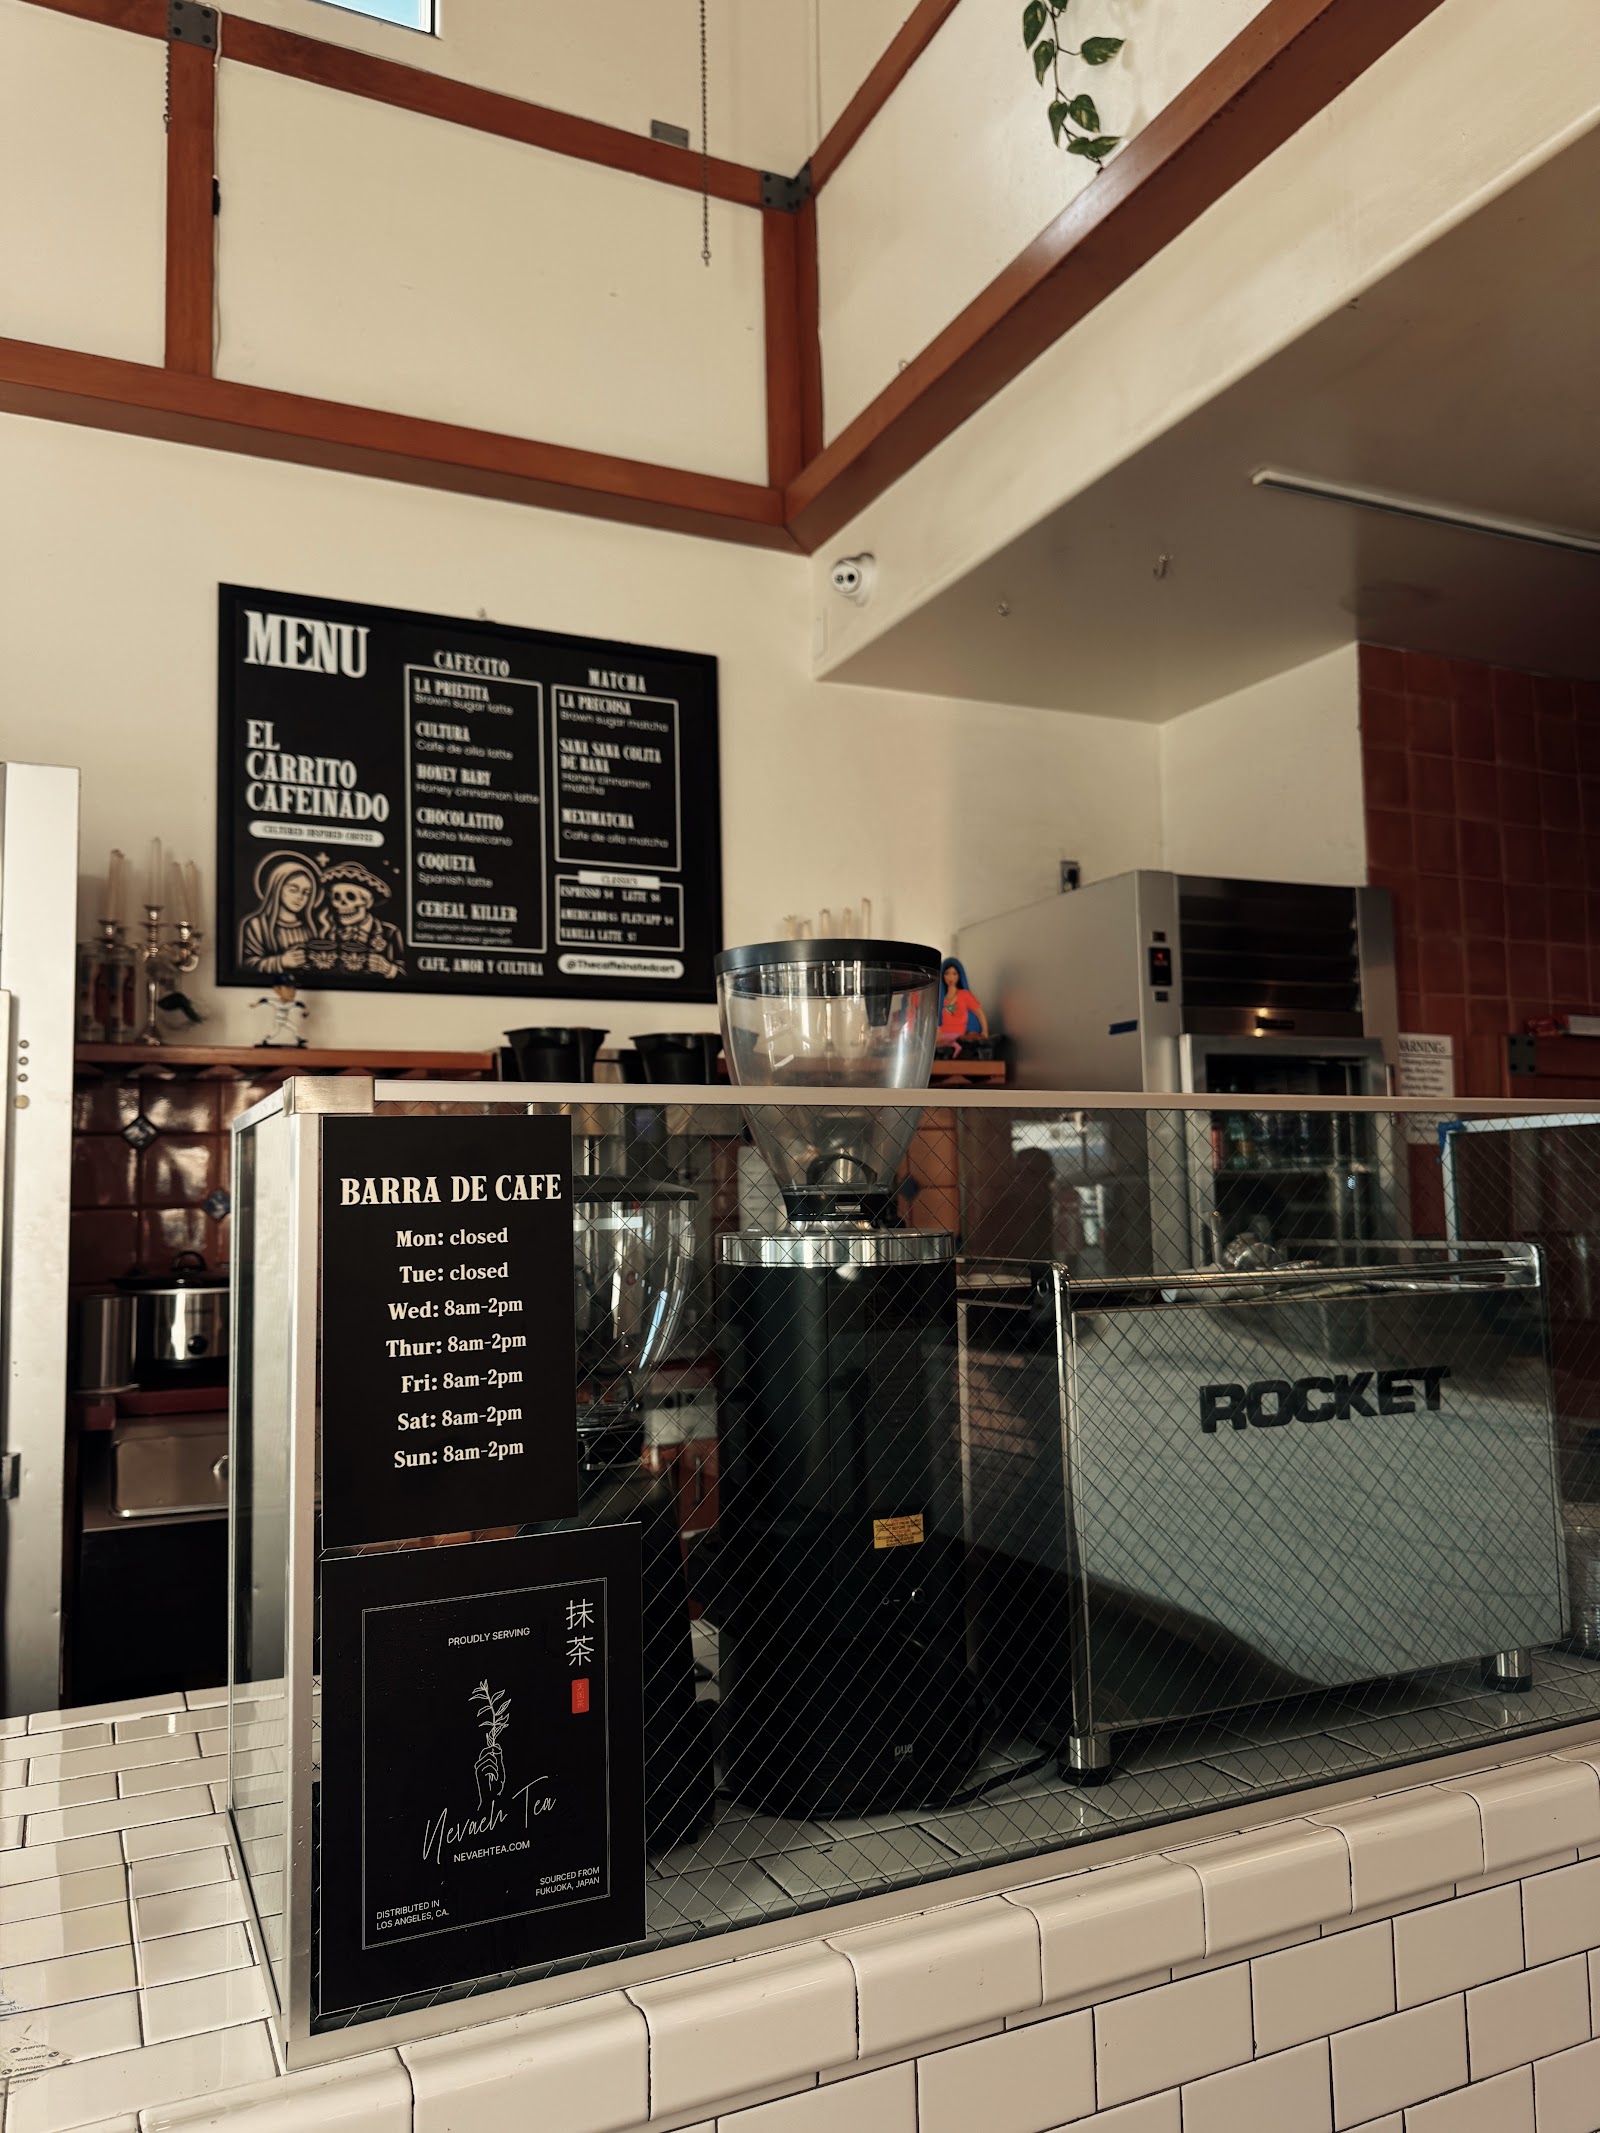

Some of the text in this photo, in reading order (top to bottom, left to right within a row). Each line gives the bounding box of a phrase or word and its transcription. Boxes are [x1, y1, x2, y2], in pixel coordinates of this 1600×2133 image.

[243, 609, 370, 678] MENU
[433, 649, 510, 677] CAFECITO
[413, 676, 431, 694] LA
[588, 668, 647, 693] MATCHA
[414, 694, 514, 715] Brown sugar latte
[558, 691, 632, 716] LA PRECIOSA
[415, 720, 471, 742] CULTURA
[560, 708, 669, 733] Brown sugar matcha
[246, 718, 280, 751] EL
[415, 739, 514, 760] Cafe de olla latte
[559, 737, 662, 764] SANA SANA COLITA
[245, 751, 357, 789] CARRITO
[416, 762, 492, 786] HONEY BABY
[560, 754, 610, 774] DE RANA
[560, 771, 651, 790] Honey cinnamon
[561, 781, 606, 796] matcha
[245, 781, 390, 822] CAFEINADO
[415, 782, 540, 804] Honey cinnamon latte
[416, 806, 504, 831] CHOCOLATITO
[561, 807, 635, 830] MEXIMATCHA
[415, 827, 513, 846] Mocha Mexicano
[562, 828, 589, 842] Cafe
[590, 831, 604, 843] de
[628, 836, 669, 848] matcha
[417, 852, 476, 872] COQUETA
[417, 871, 493, 888] Spanish latte
[560, 885, 601, 900] ESPRESSO
[621, 890, 647, 903] LATTE
[416, 900, 518, 922] CEREAL KILLER
[560, 907, 608, 922] AMERICANO
[560, 927, 595, 940] VANILLA
[597, 928, 623, 942] LATTE
[453, 958, 484, 974] AMOR
[486, 959, 495, 974] Y
[496, 960, 544, 976] CULTURA
[340, 1173, 561, 1206] BARRA DE CAFE
[396, 1227, 508, 1248] Mon: closed
[399, 1262, 509, 1284] Tue: closed
[388, 1297, 523, 1320] Wed: 8am-2pm
[385, 1333, 527, 1358] Thur: 8am-2pm
[401, 1368, 523, 1393] Fri: 8am-2pm
[1200, 1366, 1450, 1433] ROCKET
[397, 1406, 522, 1431] Sat: 8am-2pm
[393, 1441, 524, 1469] Sun: 8am-2pm
[448, 1627, 530, 1646] PROUDLY SERVING
[566, 1598, 595, 1666] 抹茶
[423, 1776, 556, 1864] Nevaeh Tea
[453, 1840, 530, 1862] NEVAEHTEA.COM
[535, 1876, 600, 1896] FUKUOKA, JAPAN
[539, 1866, 600, 1885] SOURCED FROM
[376, 1900, 440, 1920] DISTRIBUTED IN
[376, 1920, 393, 1930] LOS
[394, 1911, 434, 1927] ANGELES,
